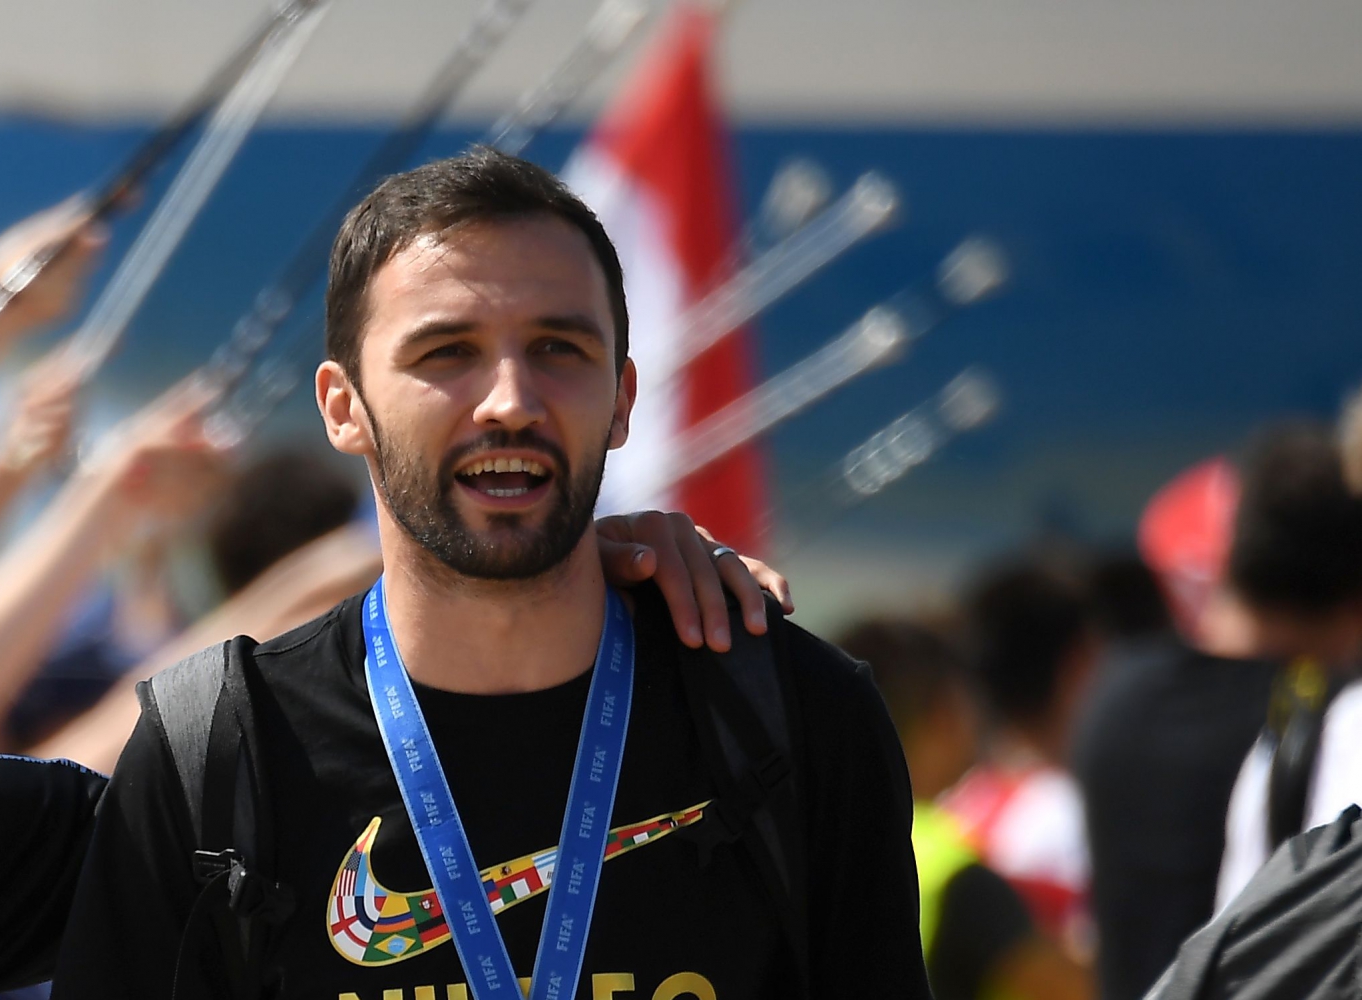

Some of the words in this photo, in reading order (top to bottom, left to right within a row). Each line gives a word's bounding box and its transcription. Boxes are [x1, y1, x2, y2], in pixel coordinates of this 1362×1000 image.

[374, 635, 388, 669] FIFA
[609, 642, 624, 673] FIFA
[387, 685, 405, 720] FIFA
[600, 695, 616, 727] FIFA
[404, 739, 423, 773] FIFA
[590, 750, 607, 783] FIFA
[422, 792, 442, 826] FIFA
[579, 806, 596, 839] FIFA
[441, 846, 461, 880] FIFA
[568, 862, 585, 895] FIFA
[462, 901, 481, 935] FIFA
[556, 918, 574, 952] FIFA
[481, 956, 501, 991] FIFA
